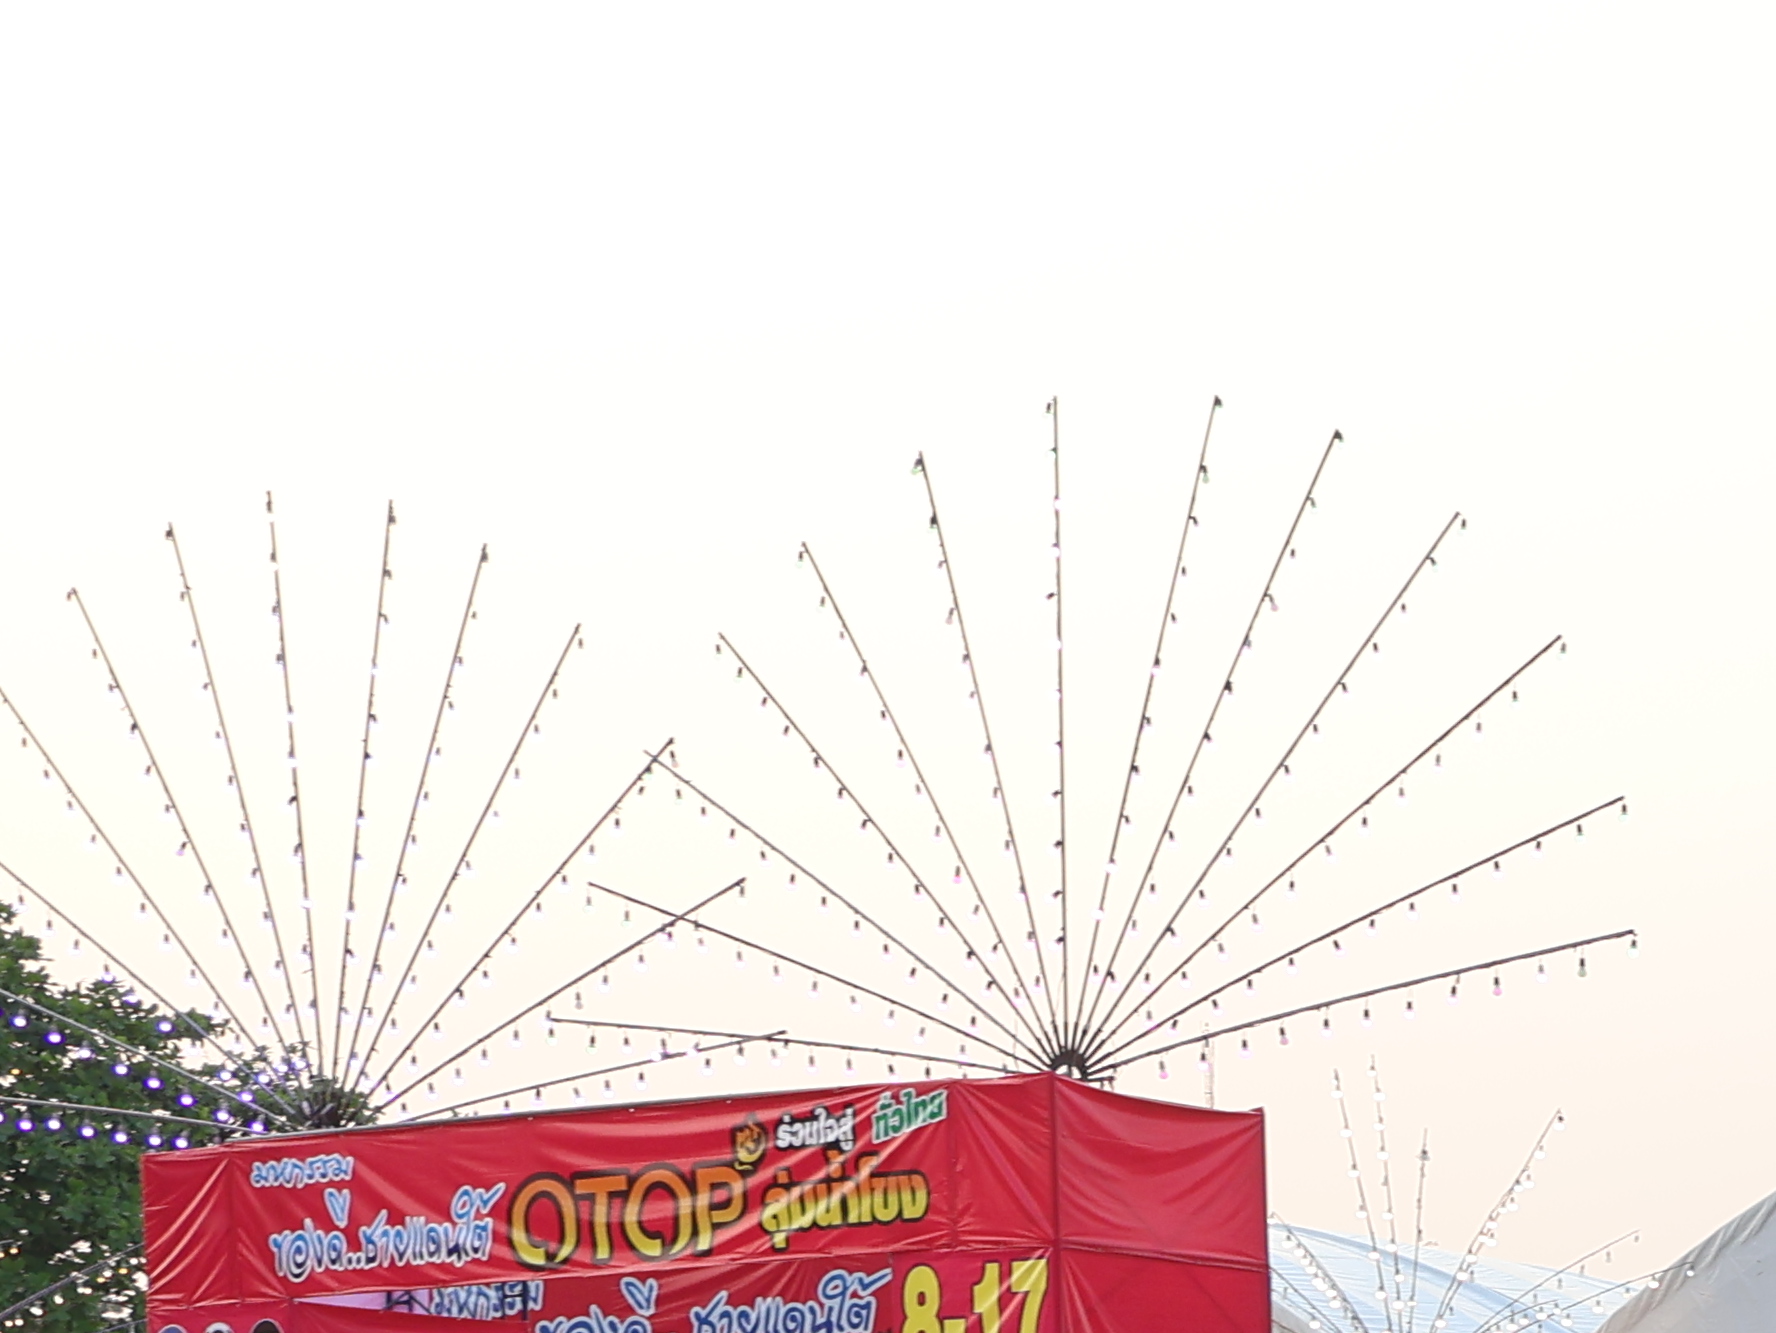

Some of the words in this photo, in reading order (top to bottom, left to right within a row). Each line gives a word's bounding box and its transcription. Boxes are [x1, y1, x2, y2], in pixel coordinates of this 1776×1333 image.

[250, 1153, 354, 1189] มหกรรม
[511, 1165, 747, 1267] OTOP
